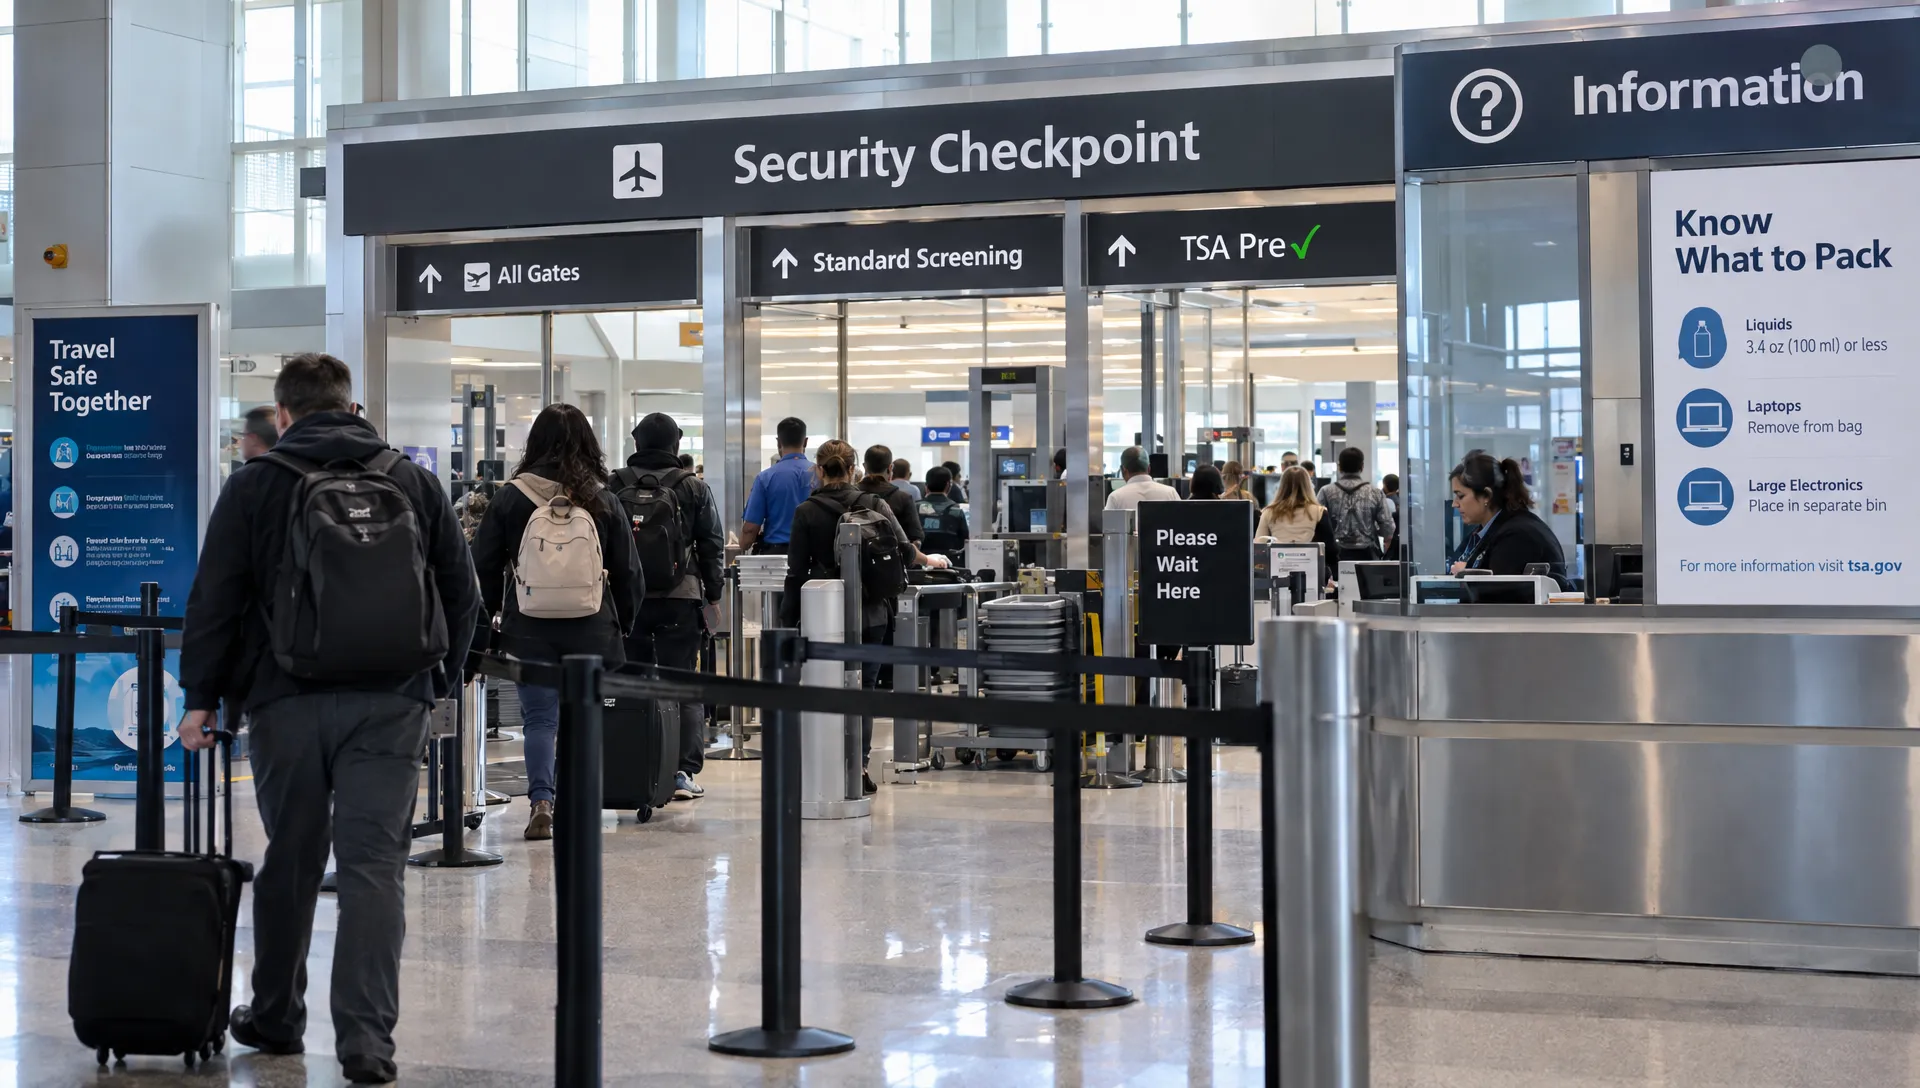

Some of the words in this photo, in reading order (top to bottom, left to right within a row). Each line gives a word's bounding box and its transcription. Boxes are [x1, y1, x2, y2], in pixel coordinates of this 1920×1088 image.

[1574, 62, 1863, 115] Information
[735, 136, 916, 187] Security
[930, 120, 1200, 178] Checkpoint
[1676, 210, 1772, 237] Know
[1180, 235, 1230, 260] TSA
[1240, 233, 1285, 258] Pre
[814, 248, 909, 272] Standard
[917, 245, 1022, 270] Screening
[1675, 245, 1763, 274] What
[1771, 246, 1806, 271] to
[1816, 239, 1892, 269] Pack
[498, 265, 521, 284] All
[528, 265, 579, 282] Gates
[1747, 318, 1792, 334] Liquids
[50, 338, 114, 359] Travel
[1747, 340, 1765, 354] 3.4
[1770, 343, 1784, 353] oz
[1789, 338, 1815, 355] (100
[1820, 337, 1839, 354] ml)
[1844, 341, 1858, 351] or
[1862, 337, 1887, 351] less
[51, 365, 97, 385] Safe
[50, 390, 151, 416] Together
[1748, 400, 1801, 415] Laptops
[1749, 421, 1799, 433] Remove
[1804, 420, 1833, 432] from
[1839, 419, 1862, 435] bag
[1749, 480, 1786, 494] Large
[1791, 479, 1862, 491] Electronics
[1750, 499, 1784, 512] Place
[1788, 499, 1800, 512] in
[1804, 500, 1862, 515] separate
[1867, 498, 1886, 511] bin
[1157, 529, 1217, 545] Please
[1157, 556, 1198, 572] Wait
[1681, 560, 1700, 571] For
[1704, 563, 1736, 572] more
[1741, 559, 1814, 572] information
[1818, 559, 1844, 571] visit
[1848, 560, 1902, 575] tsa.gov
[1157, 583, 1200, 599] Here
